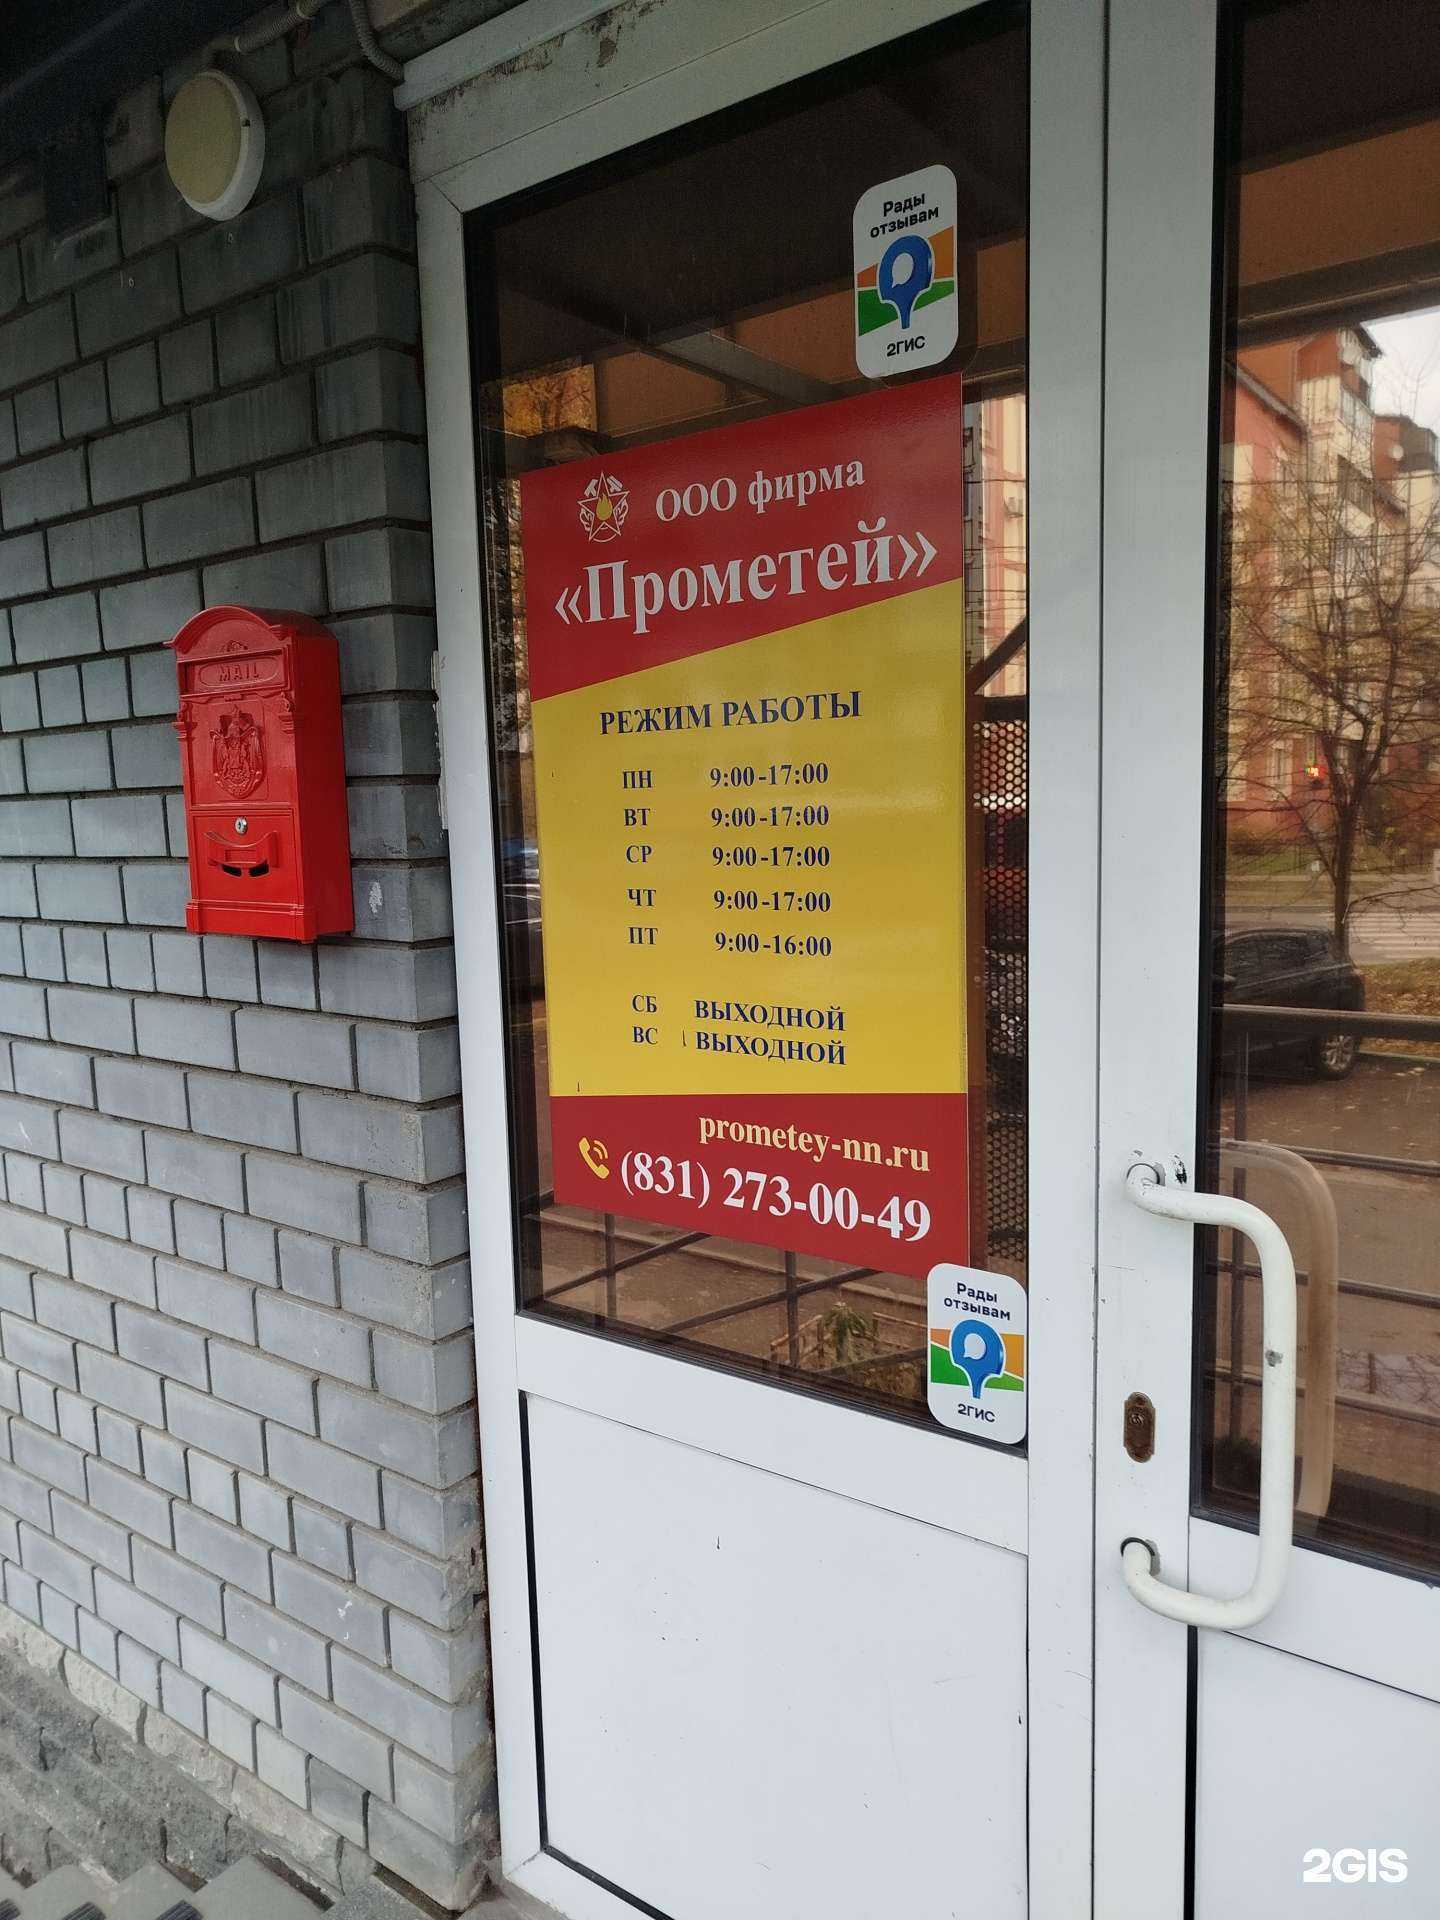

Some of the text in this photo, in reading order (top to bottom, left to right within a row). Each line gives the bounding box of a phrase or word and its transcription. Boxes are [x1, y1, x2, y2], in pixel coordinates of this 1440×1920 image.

[883, 193, 926, 217] Рады
[870, 206, 939, 238] отзывам
[886, 335, 926, 357] 2ГИС
[655, 460, 866, 522] ООО фирма
[554, 516, 938, 634] «Прометей»
[218, 660, 261, 682] MAIL
[599, 690, 863, 735] РЕЖИМ РАБОТЫ
[622, 762, 829, 789] ПН 9:00-17:00
[623, 804, 830, 828] ВТ 9:00-17:00
[626, 845, 831, 867] СР 9:00-17:00
[627, 888, 832, 913] ЧТ 9:00-17:00
[628, 926, 832, 957] ПТ 9:00-16:00
[631, 994, 847, 1032] СБ ВЫХОДНОЙ
[631, 1026, 847, 1066] ВС ВЫХОДНОЙ
[698, 1115, 931, 1174] prometey-nn.ru
[620, 1150, 933, 1244] (831) 273-00-49
[956, 1282, 998, 1303] Рады
[943, 1297, 1011, 1321] отзывам
[957, 1403, 996, 1423] 2ГИС
